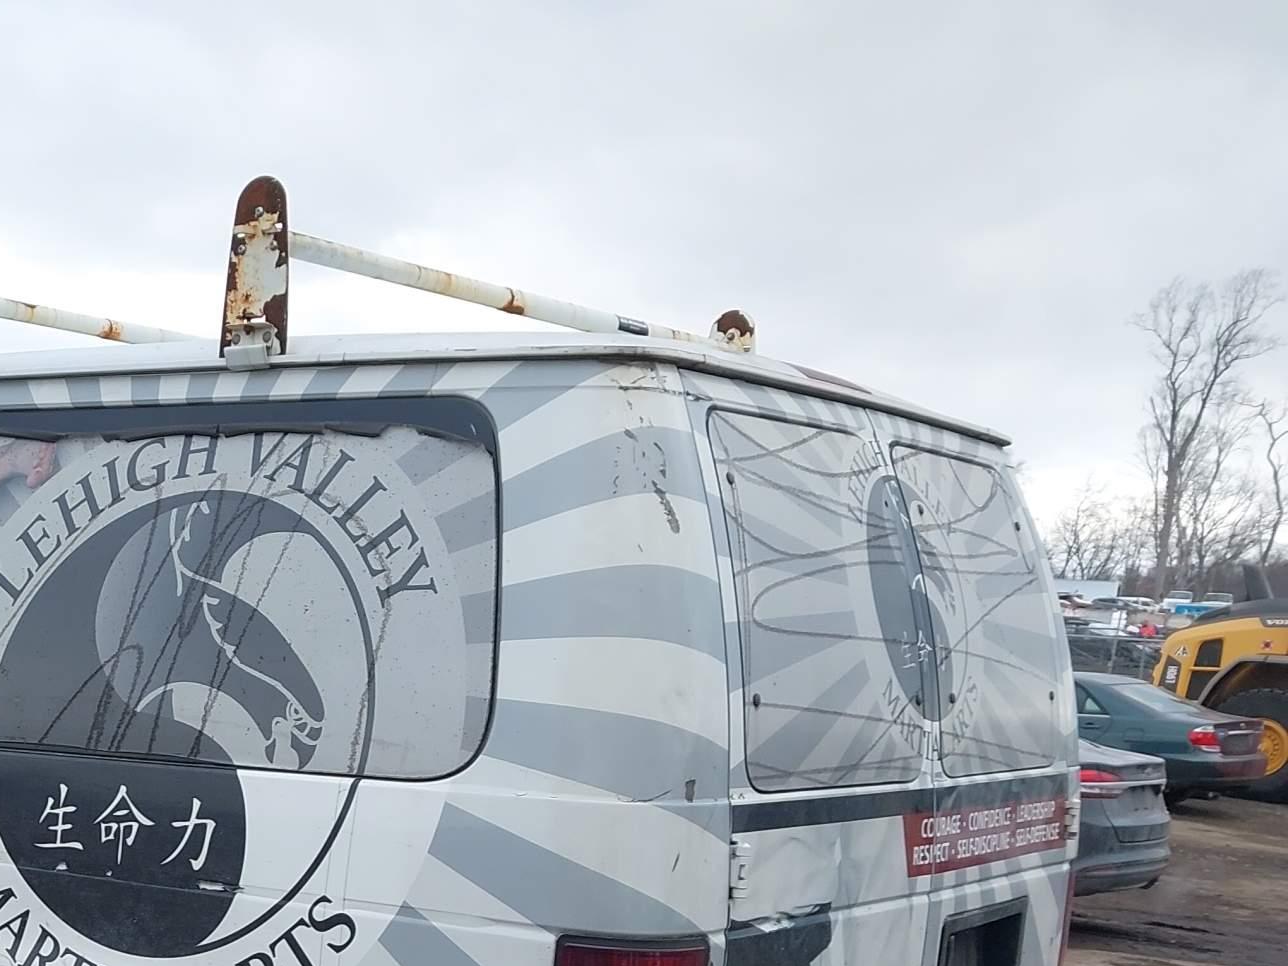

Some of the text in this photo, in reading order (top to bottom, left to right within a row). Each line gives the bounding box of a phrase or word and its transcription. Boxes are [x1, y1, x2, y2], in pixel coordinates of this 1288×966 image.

[245, 433, 438, 608] VALLEY
[33, 783, 217, 871] 生命力
[920, 800, 1056, 839] COURAGE CONFIDENCE LEADERSHIP
[956, 831, 1010, 860] SELF-DISCIPLINE
[1015, 822, 1061, 848] SELF-DEFENSE
